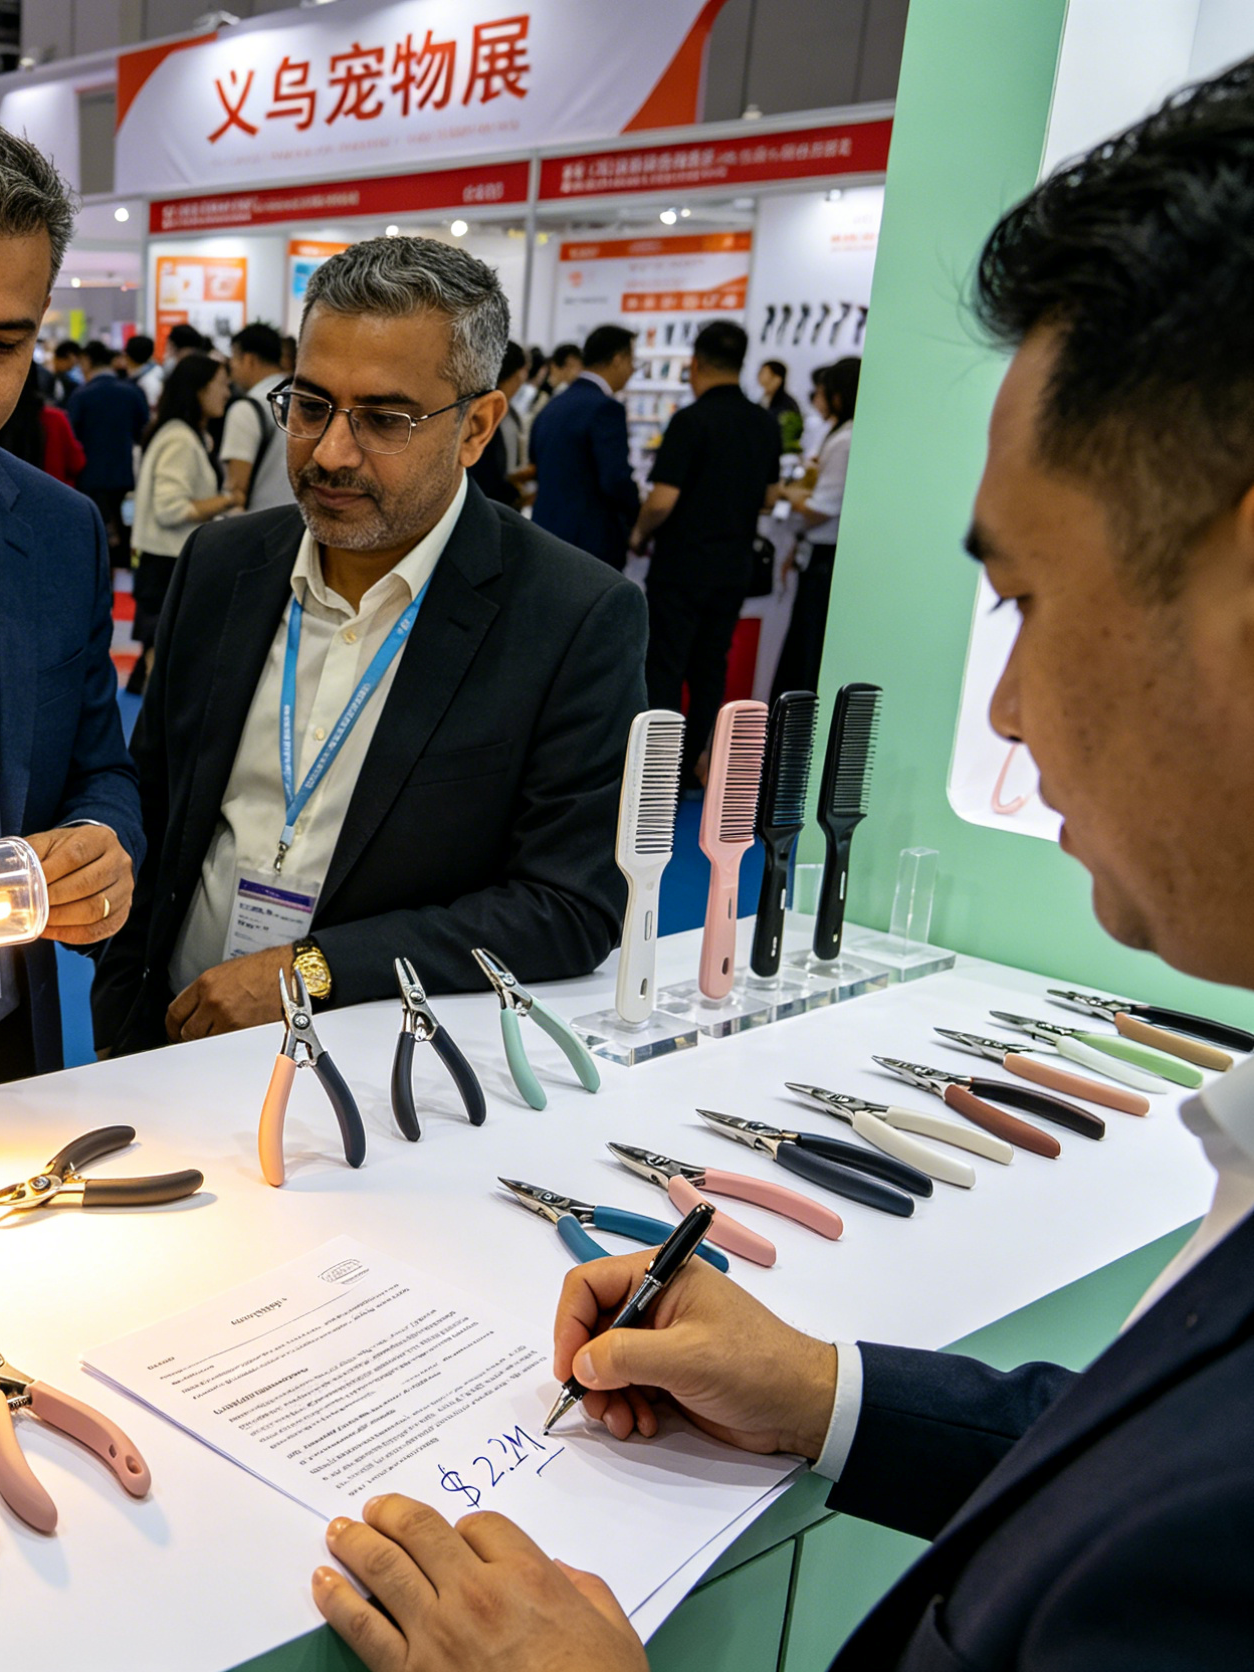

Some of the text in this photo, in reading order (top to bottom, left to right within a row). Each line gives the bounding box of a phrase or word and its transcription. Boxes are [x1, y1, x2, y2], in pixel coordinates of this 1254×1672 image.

[207, 14, 531, 145] 义乌宠物展
